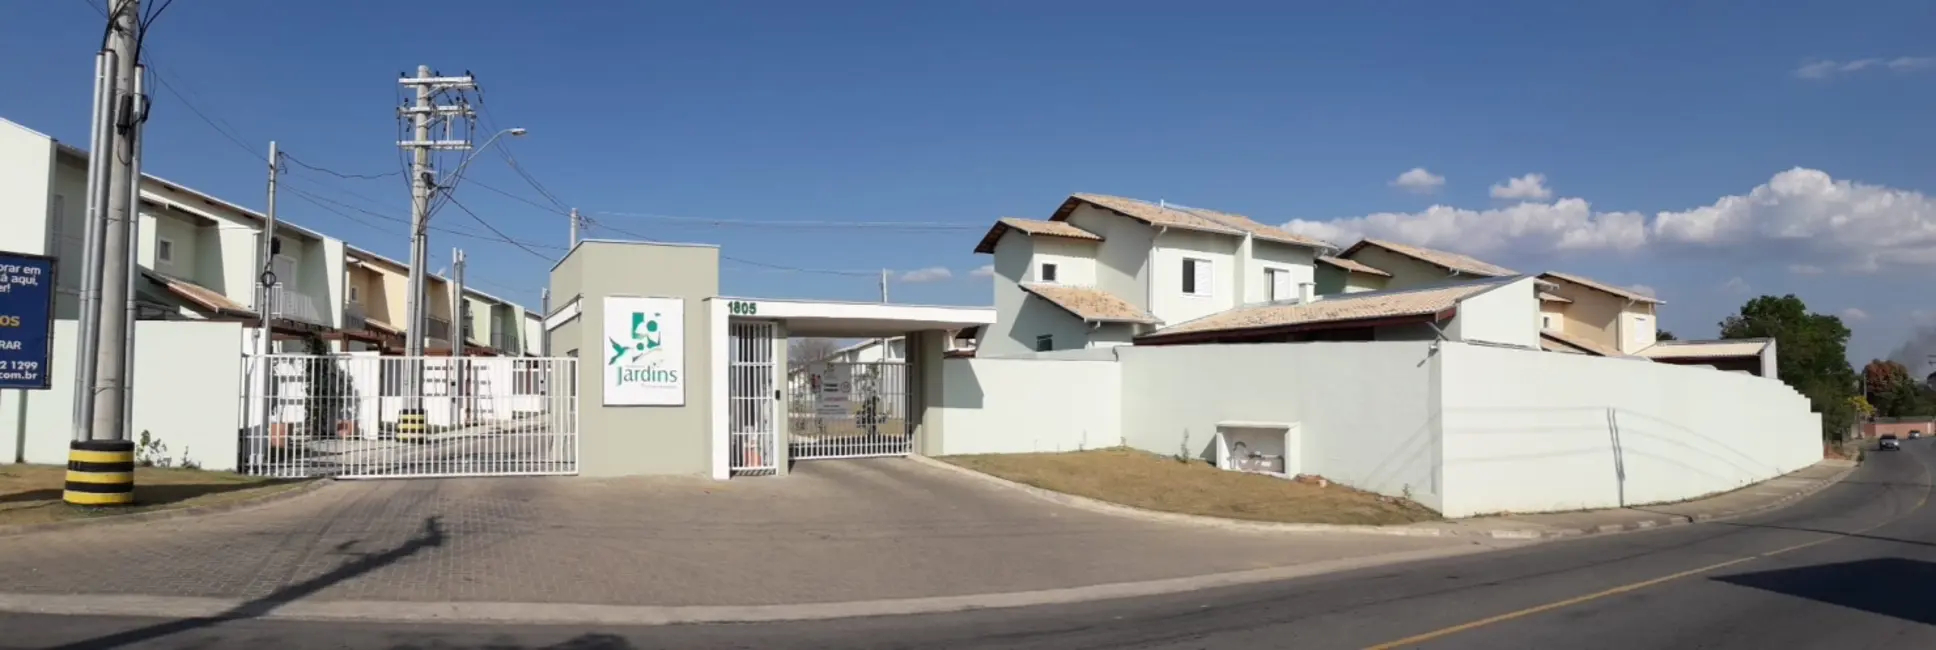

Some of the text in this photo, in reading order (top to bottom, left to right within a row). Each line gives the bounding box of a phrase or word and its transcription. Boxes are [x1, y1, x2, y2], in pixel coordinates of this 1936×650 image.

[23, 266, 41, 275] em
[11, 275, 38, 286] aqui,
[728, 300, 757, 315] 1805
[11, 360, 38, 370] 1299
[615, 362, 678, 387] Jardins
